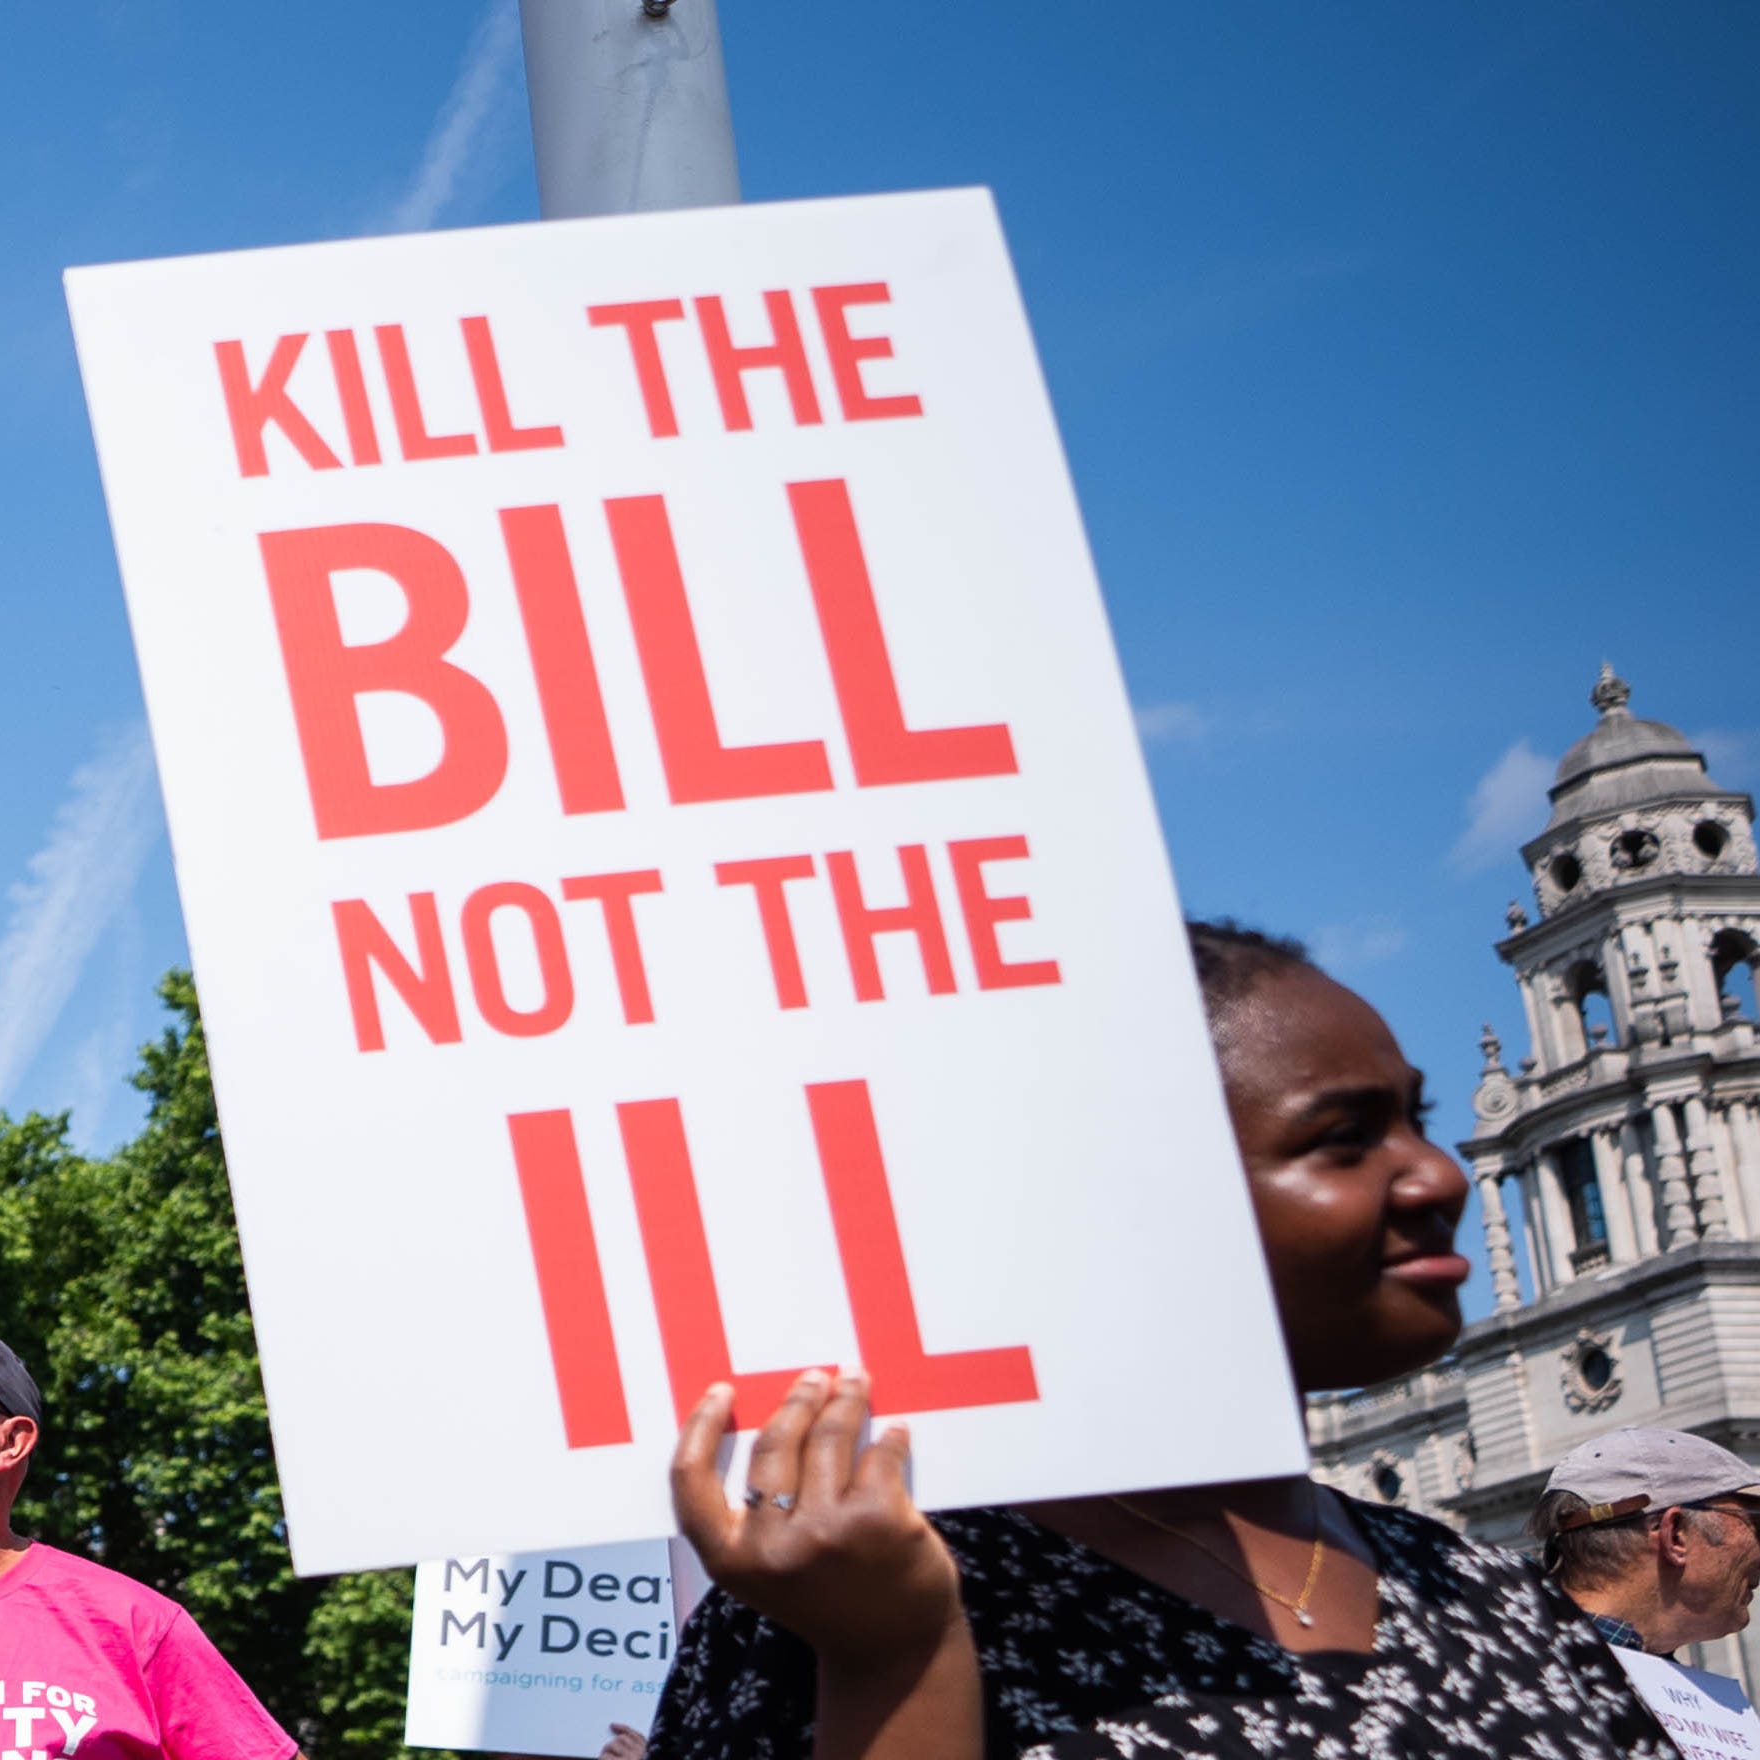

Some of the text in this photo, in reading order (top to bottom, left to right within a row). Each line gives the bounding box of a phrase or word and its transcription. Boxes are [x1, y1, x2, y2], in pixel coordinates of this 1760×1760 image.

[214, 281, 925, 479] KILL THE
[258, 478, 1021, 841] BILL
[330, 834, 1063, 1054] NOT THE
[507, 1078, 1040, 1451] ILL
[440, 1609, 669, 1662] My Deci
[443, 1558, 671, 1607] My Dea
[22, 1681, 97, 1717] FOR
[591, 1673, 624, 1691] for
